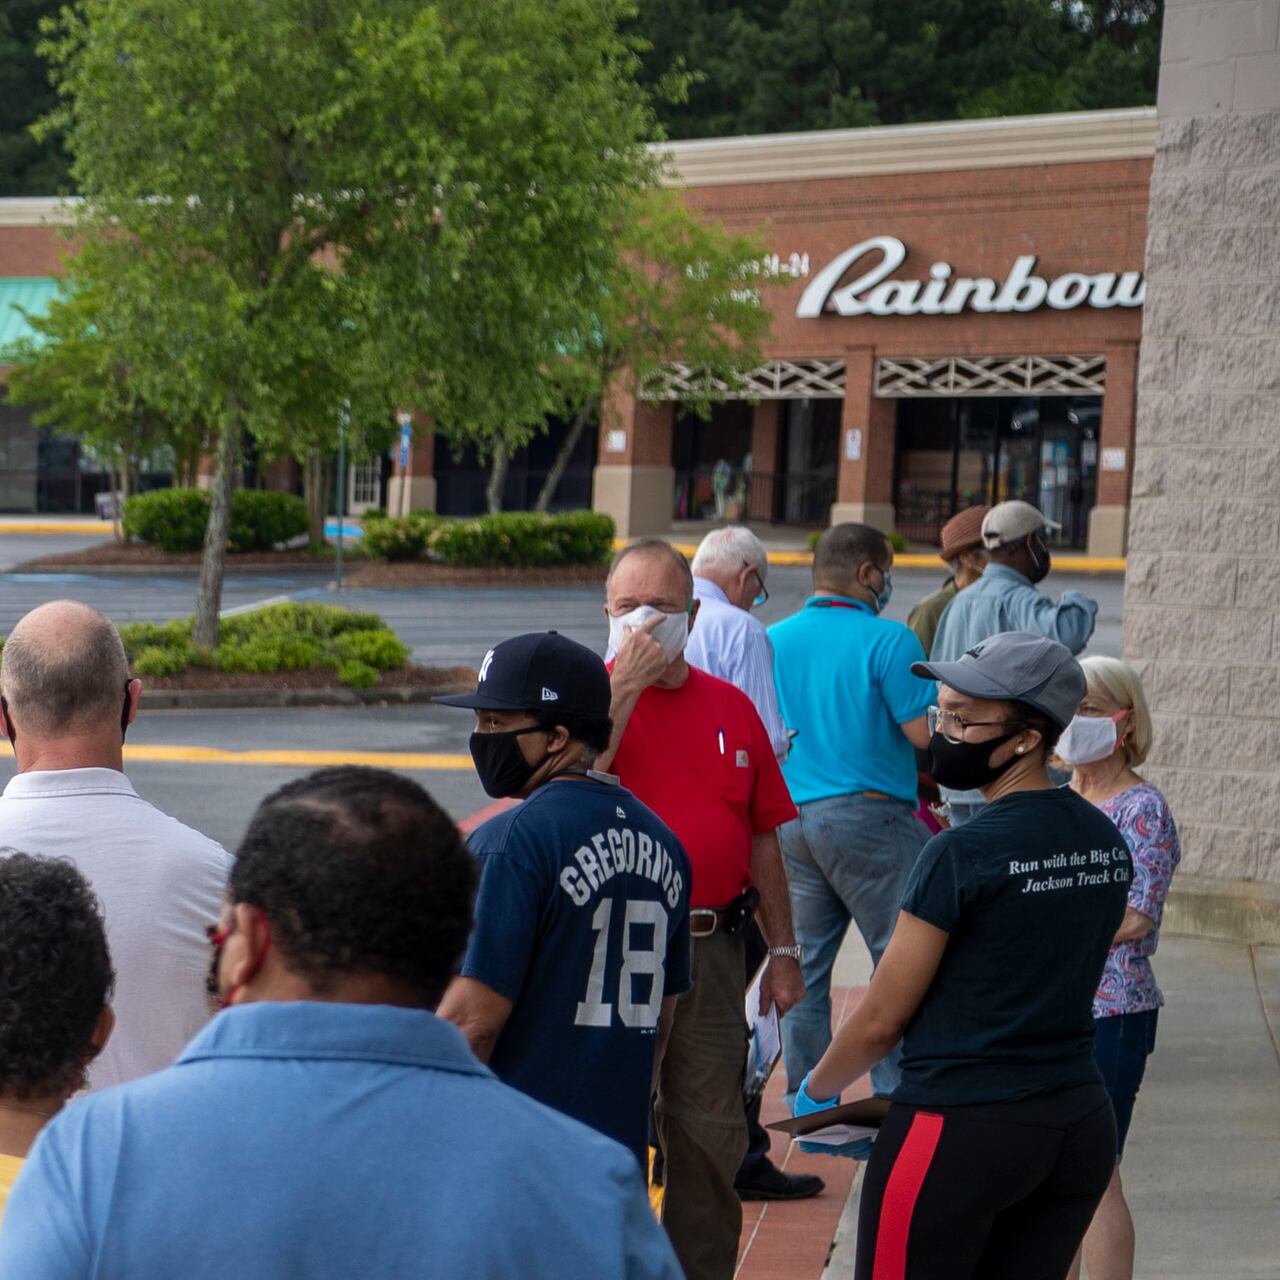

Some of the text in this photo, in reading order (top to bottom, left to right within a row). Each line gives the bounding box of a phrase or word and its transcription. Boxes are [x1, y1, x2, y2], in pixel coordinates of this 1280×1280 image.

[796, 235, 1146, 318] Rainbow
[559, 827, 683, 908] GREGORIUS
[1008, 860, 1039, 875] Run
[1042, 853, 1067, 869] with
[1070, 851, 1087, 866] the
[1090, 849, 1110, 866] Big
[1021, 876, 1073, 893] Jackson
[1077, 869, 1110, 886] Track
[573, 898, 669, 1028] 18
